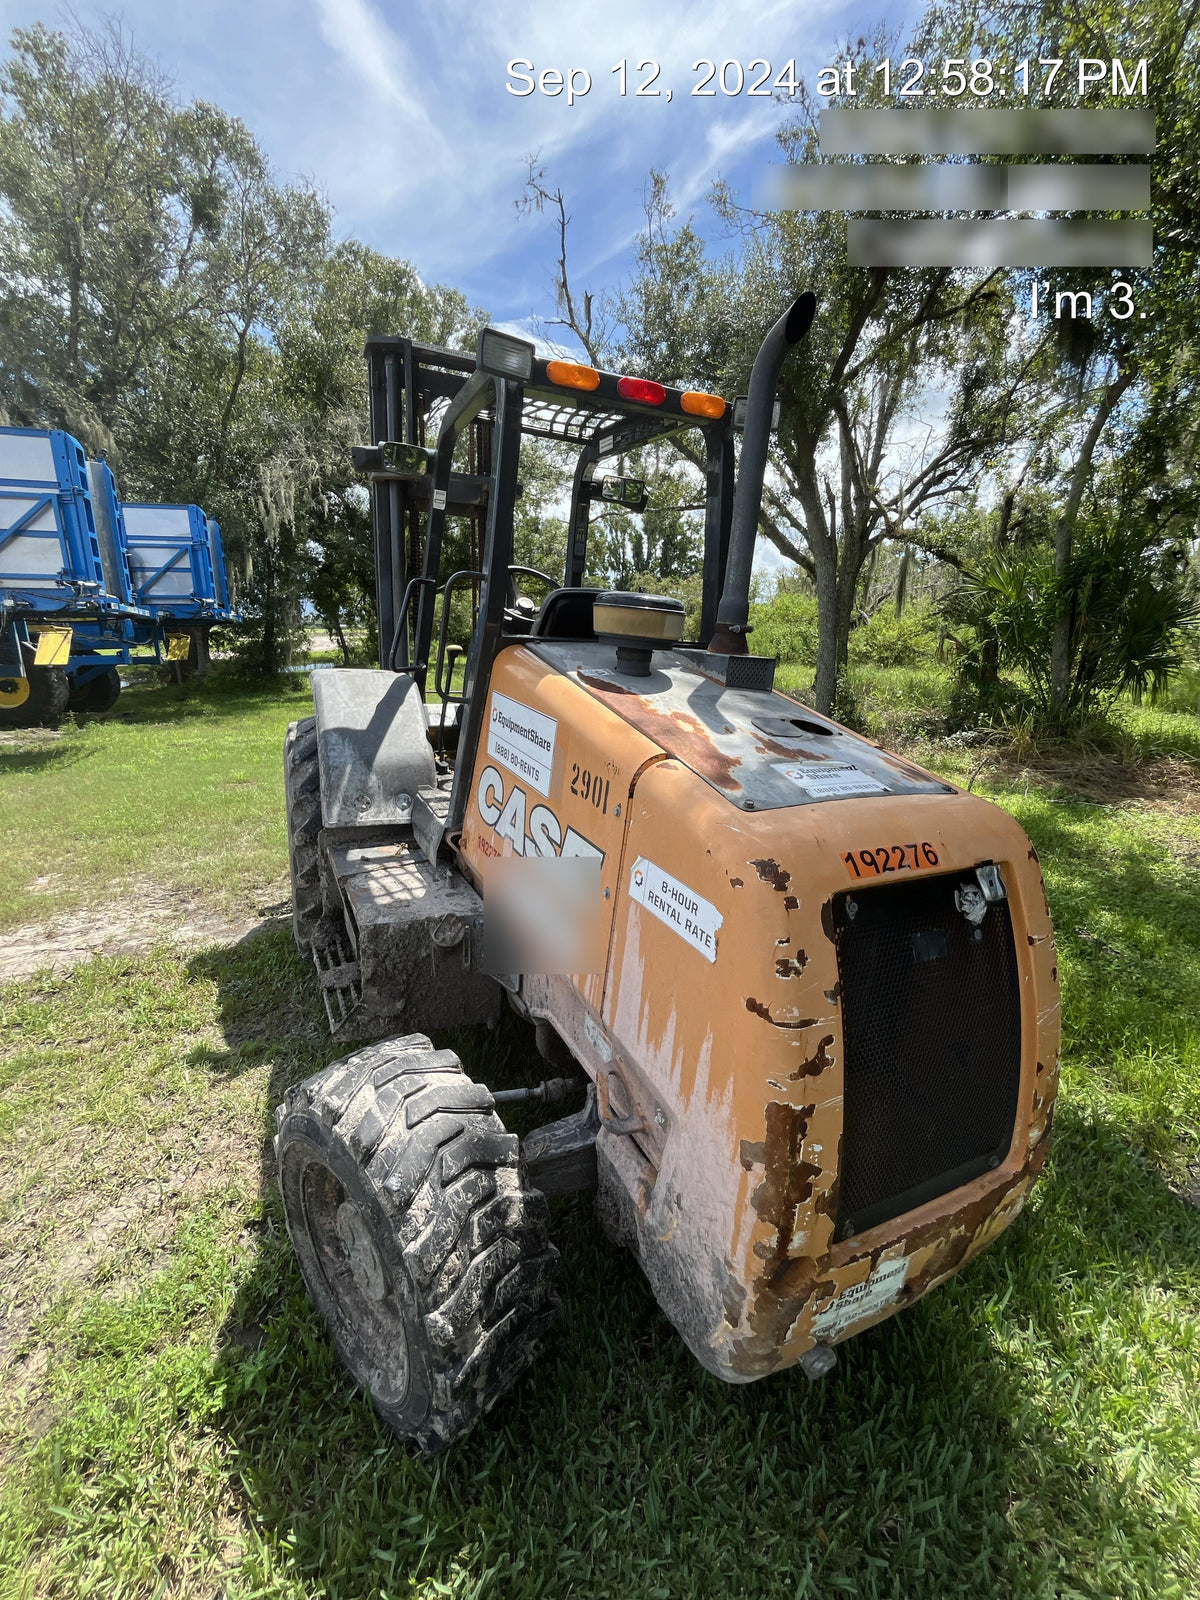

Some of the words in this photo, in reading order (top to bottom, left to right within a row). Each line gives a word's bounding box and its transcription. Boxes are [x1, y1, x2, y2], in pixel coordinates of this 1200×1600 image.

[497, 711, 552, 753] EquipmentShare
[494, 741, 510, 762] (888)
[800, 764, 859, 775] Equipment
[570, 762, 610, 814] 2901
[844, 841, 940, 877] 192276
[661, 880, 699, 917] 8-HOUR
[647, 890, 682, 927] RENTAL
[684, 918, 713, 949] RATE
